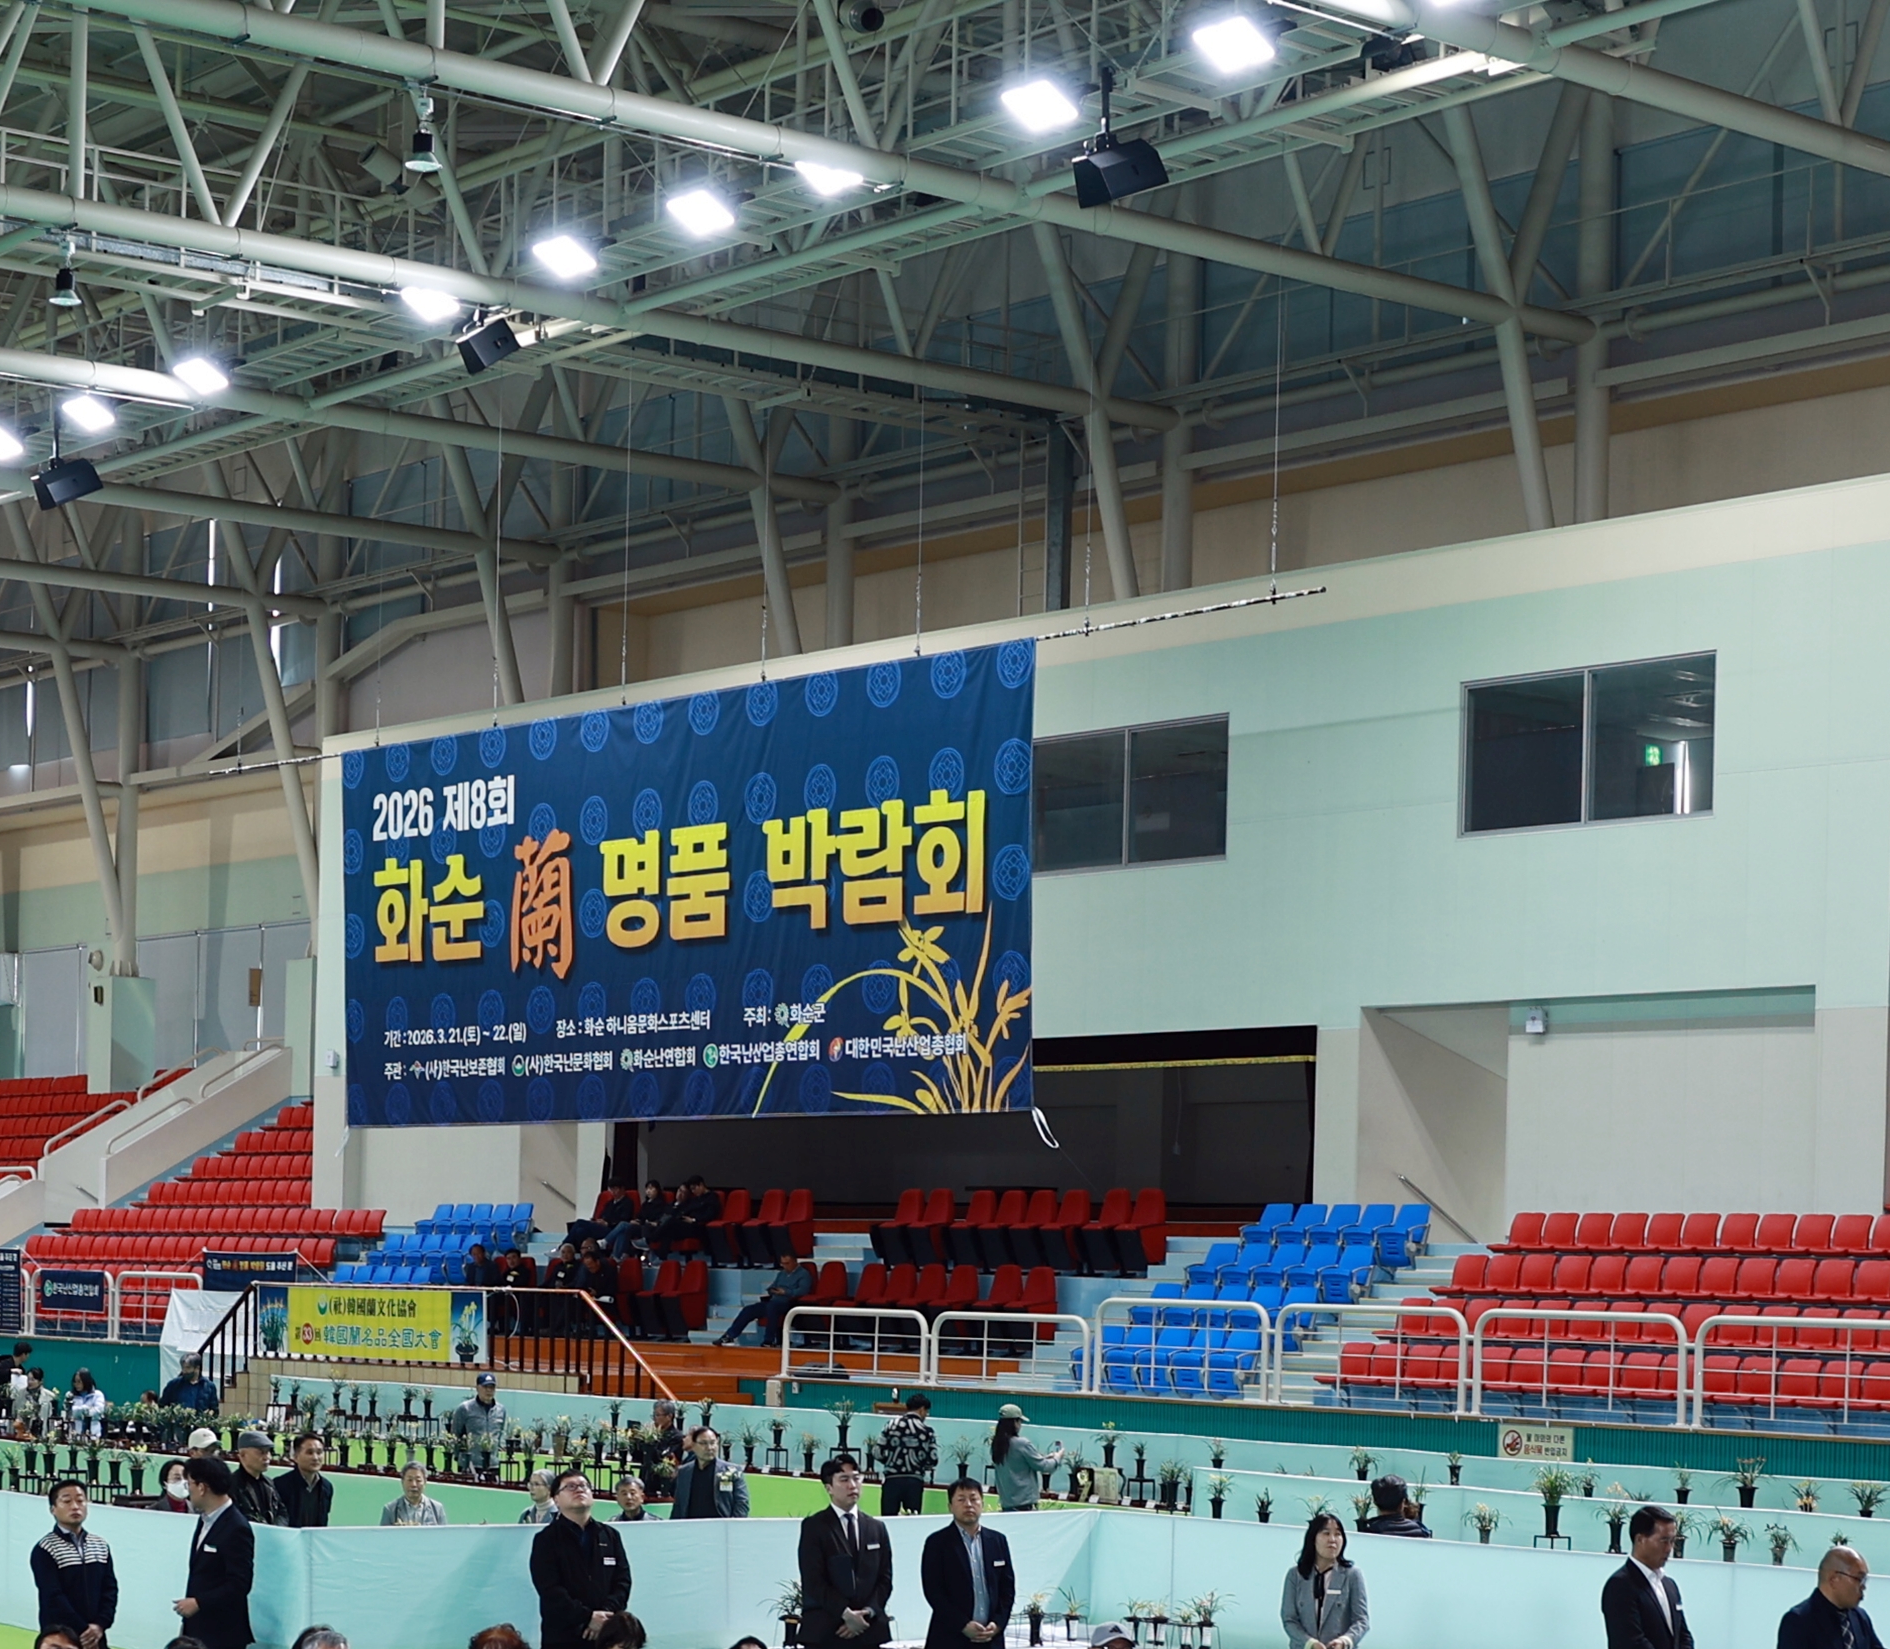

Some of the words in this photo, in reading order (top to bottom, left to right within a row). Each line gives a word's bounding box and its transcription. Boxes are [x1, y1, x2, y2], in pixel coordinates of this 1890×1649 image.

[372, 786, 434, 841] 2026
[442, 775, 515, 833] 제8회
[373, 854, 486, 963] 화순
[511, 828, 574, 979] 蘭
[599, 821, 730, 949] 명품
[762, 788, 986, 929] 박람회
[584, 1016, 604, 1037] 화순
[605, 1009, 711, 1036] 하니움문화스포츠센터
[789, 1003, 826, 1024] 화순군
[425, 1056, 506, 1081] (사)한국난보존협회
[525, 1051, 613, 1076] (사)한국난문화협회
[633, 1046, 696, 1069] 화순난연합회
[718, 1039, 820, 1065] 한국난산업총연합회
[844, 1033, 967, 1059] 대한민국난산업총협회
